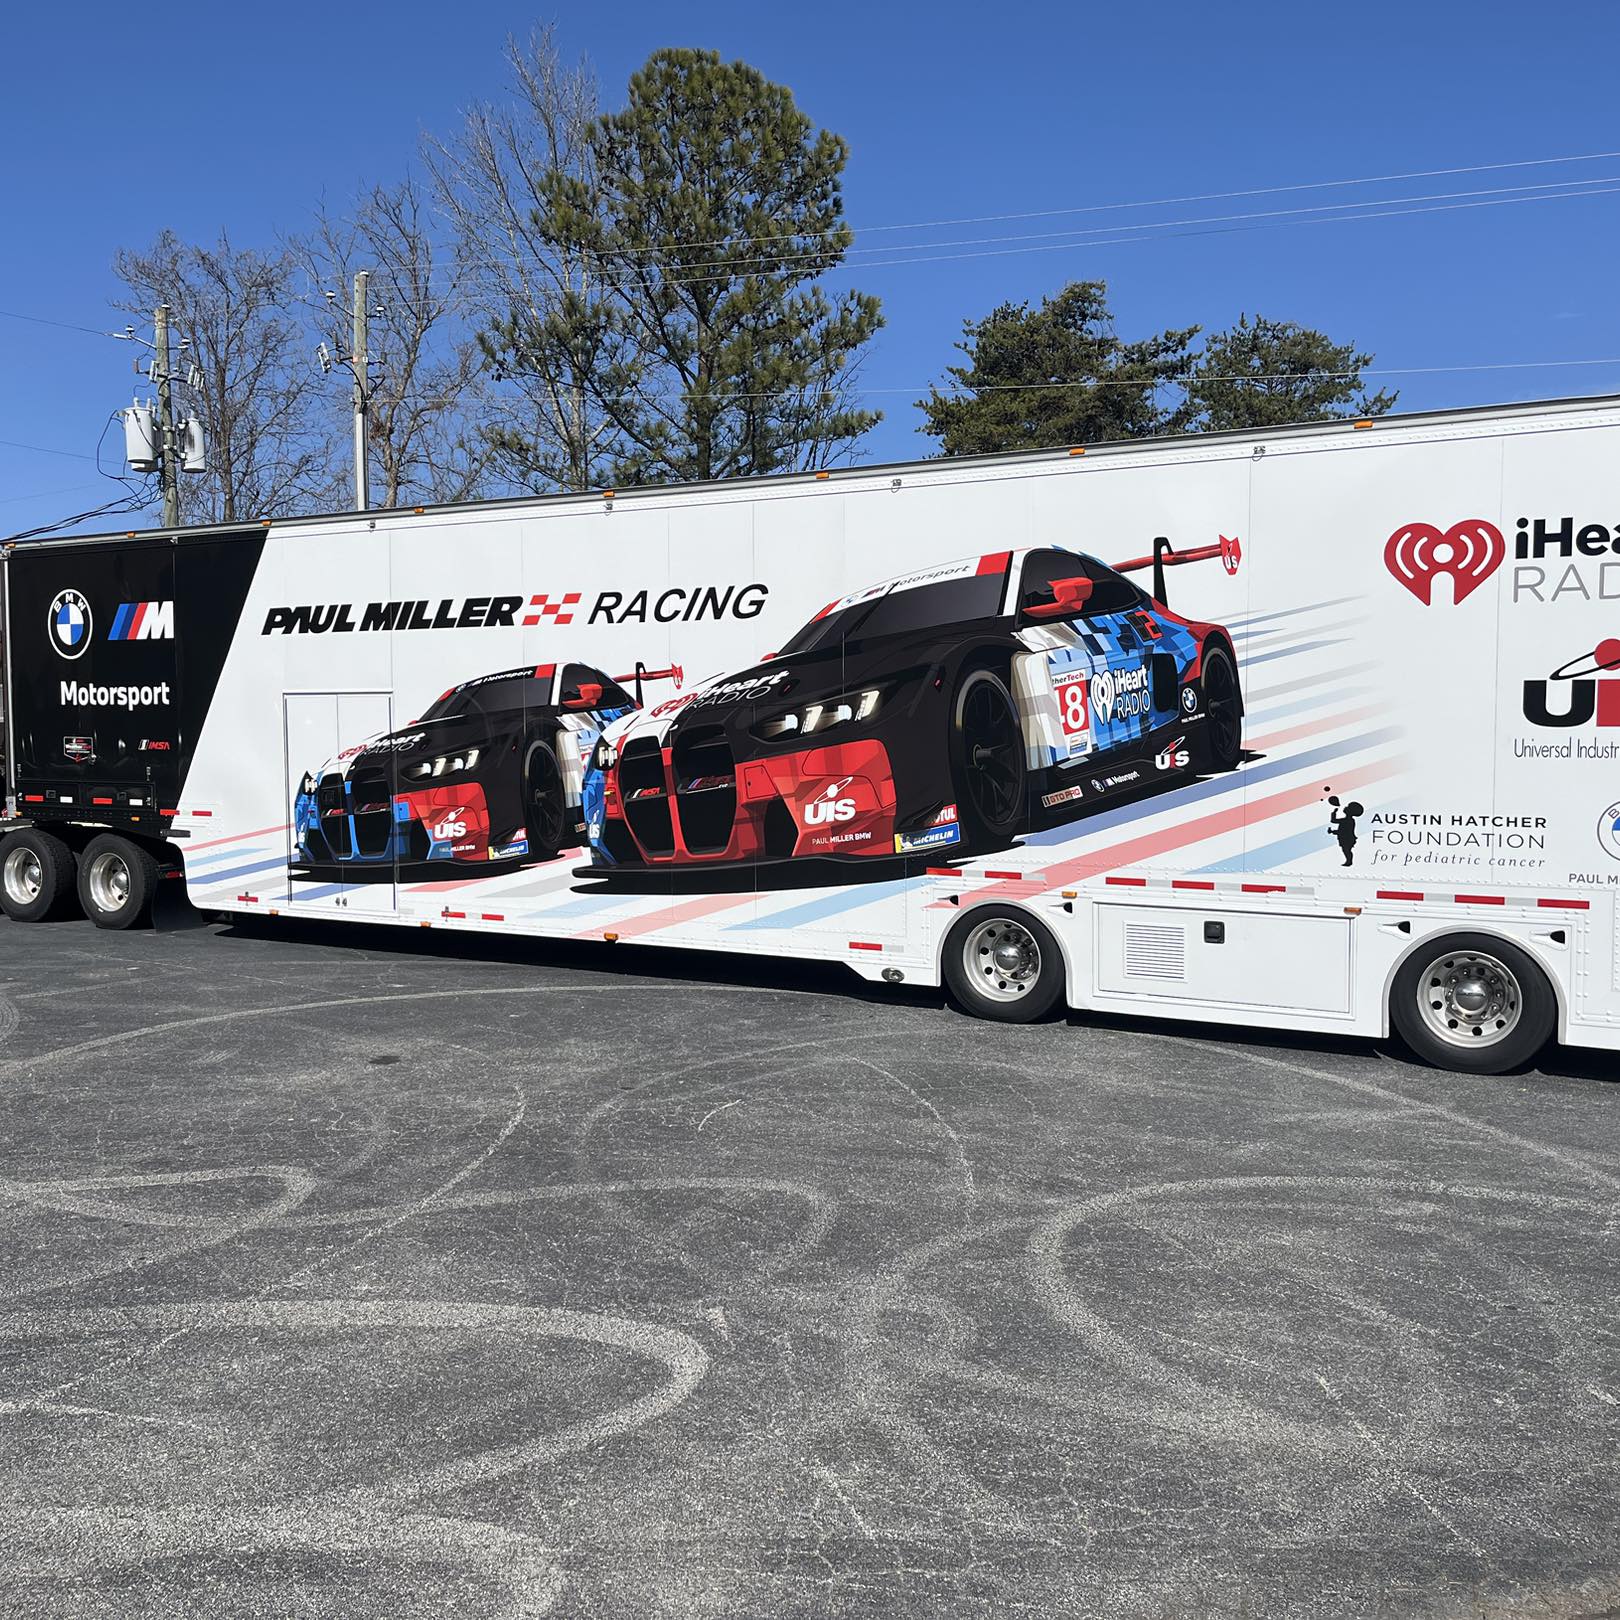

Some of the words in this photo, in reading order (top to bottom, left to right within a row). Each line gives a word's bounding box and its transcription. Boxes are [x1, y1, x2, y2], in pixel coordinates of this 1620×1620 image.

[53, 592, 87, 614] BMW
[261, 603, 356, 636] PAUL
[359, 595, 524, 632] MILLER
[587, 583, 769, 625] RACING
[1114, 664, 1148, 694] iHeart
[60, 680, 170, 711] Motorsport
[1116, 689, 1151, 720] RADIO
[1514, 736, 1572, 758] Universal
[1577, 737, 1620, 758] Industr
[1155, 750, 1190, 770] UIS
[804, 799, 856, 825] UIS
[1371, 813, 1442, 826] AUSTIN
[1451, 815, 1547, 829] HATCHER
[434, 822, 467, 839] UIS
[812, 837, 829, 845] PAUL
[829, 833, 855, 843] MILLER
[855, 832, 872, 841] BMW
[1372, 829, 1544, 849] FOUNDATION
[1371, 850, 1397, 865] for
[1404, 851, 1481, 867] pediatric
[1488, 858, 1546, 868] cancer
[1568, 873, 1604, 885] PAUL
